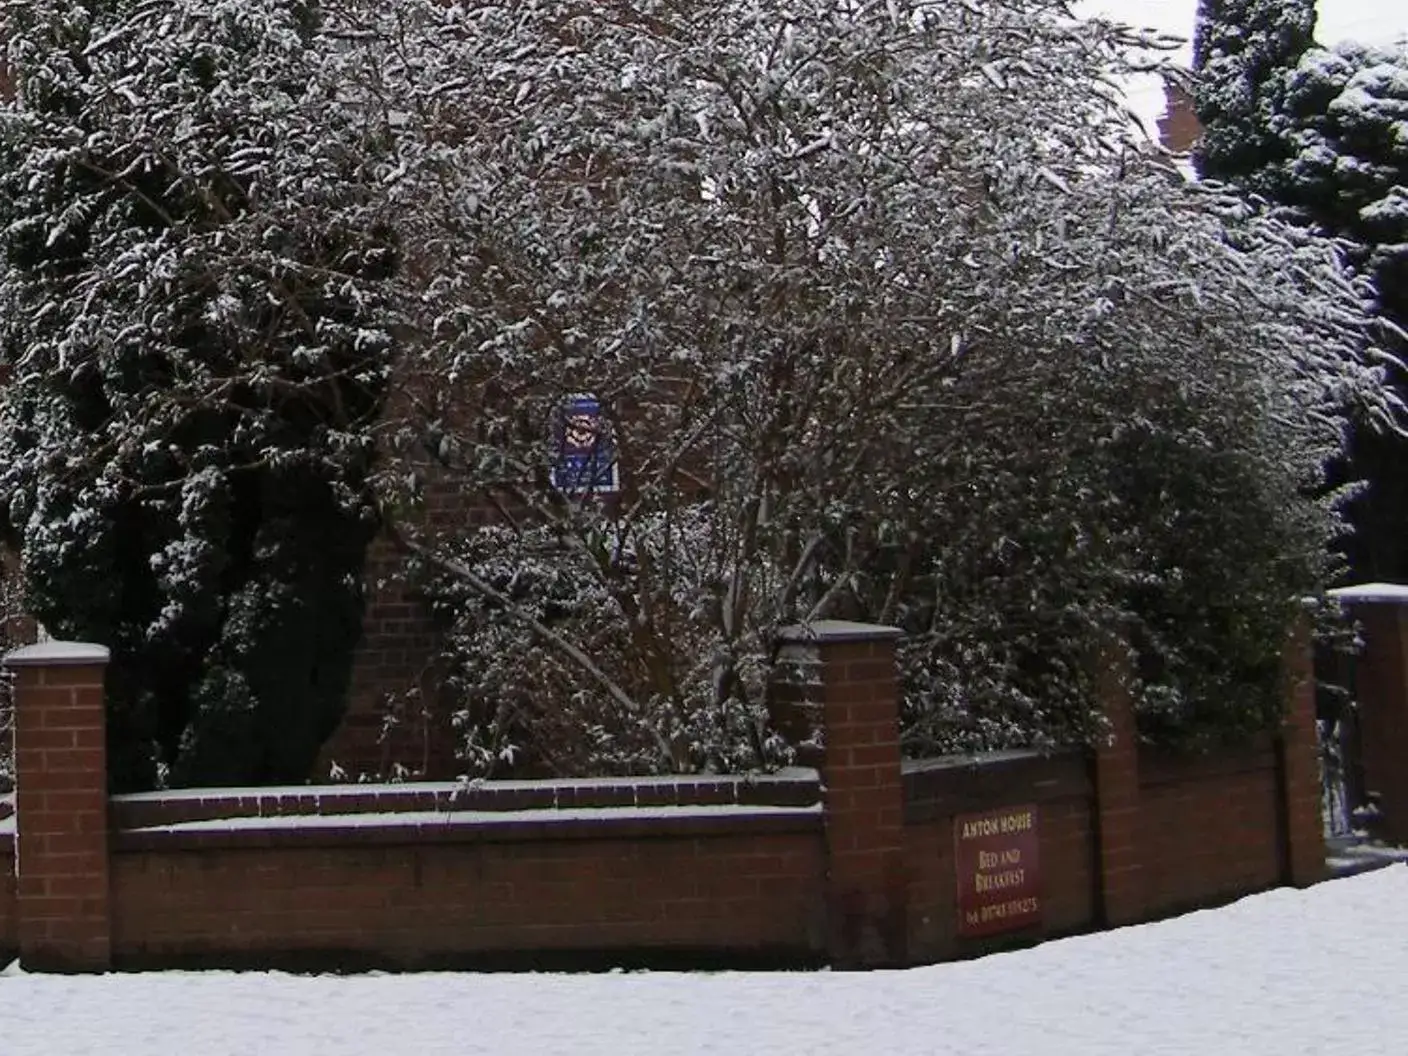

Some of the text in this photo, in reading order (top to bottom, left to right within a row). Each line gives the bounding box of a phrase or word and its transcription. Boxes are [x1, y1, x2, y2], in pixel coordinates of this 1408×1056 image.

[963, 812, 1032, 840] ANTON HOUSE
[979, 850, 998, 869] BED
